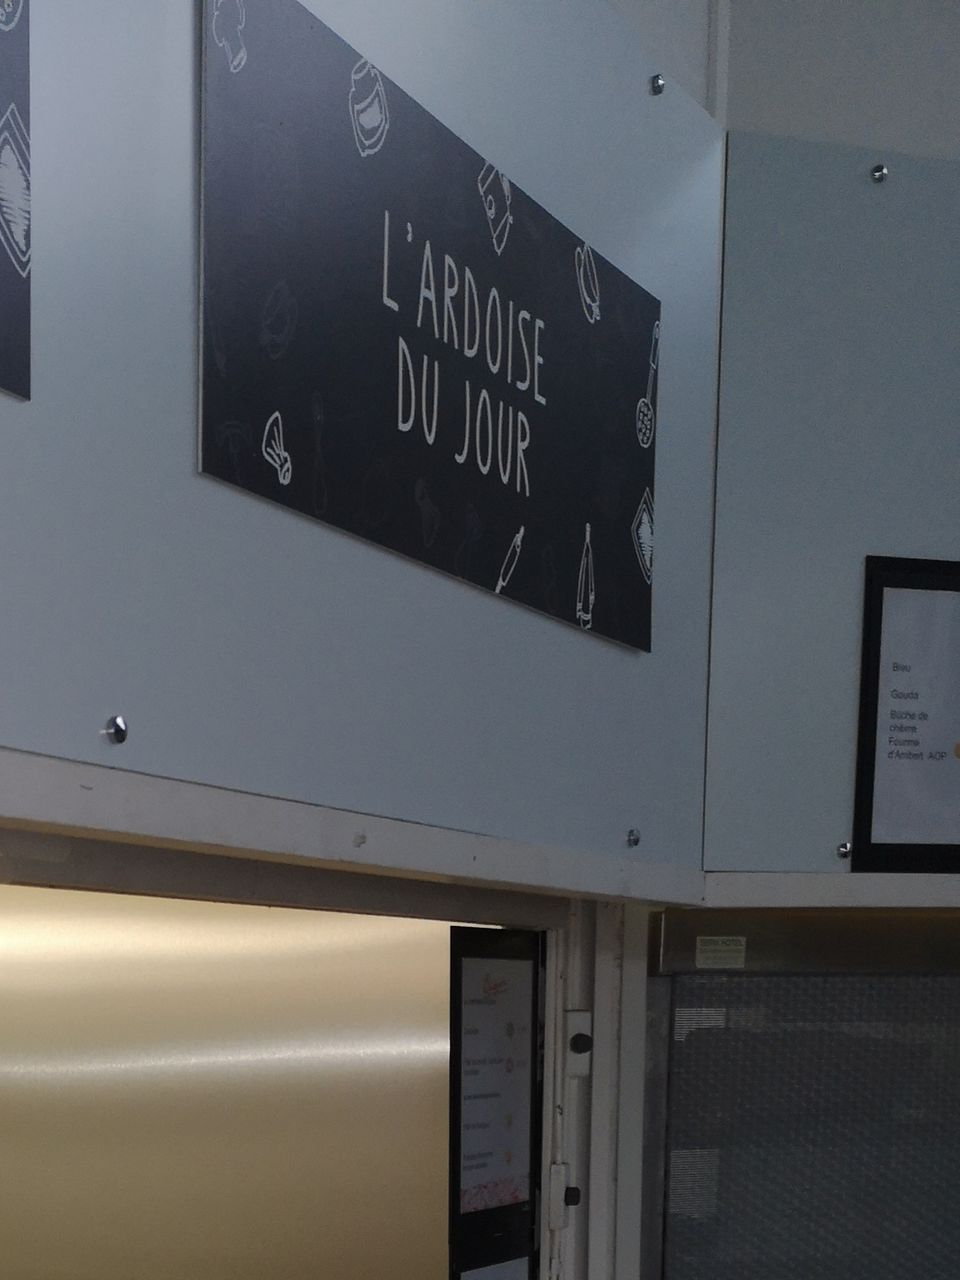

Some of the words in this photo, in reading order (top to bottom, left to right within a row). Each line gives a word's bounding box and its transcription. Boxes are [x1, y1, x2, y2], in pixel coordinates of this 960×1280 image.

[382, 209, 547, 406] L'ARDOISE
[397, 335, 439, 445] DU
[454, 379, 531, 498] JOUR
[890, 689, 919, 700] Gouda
[918, 711, 929, 721] de
